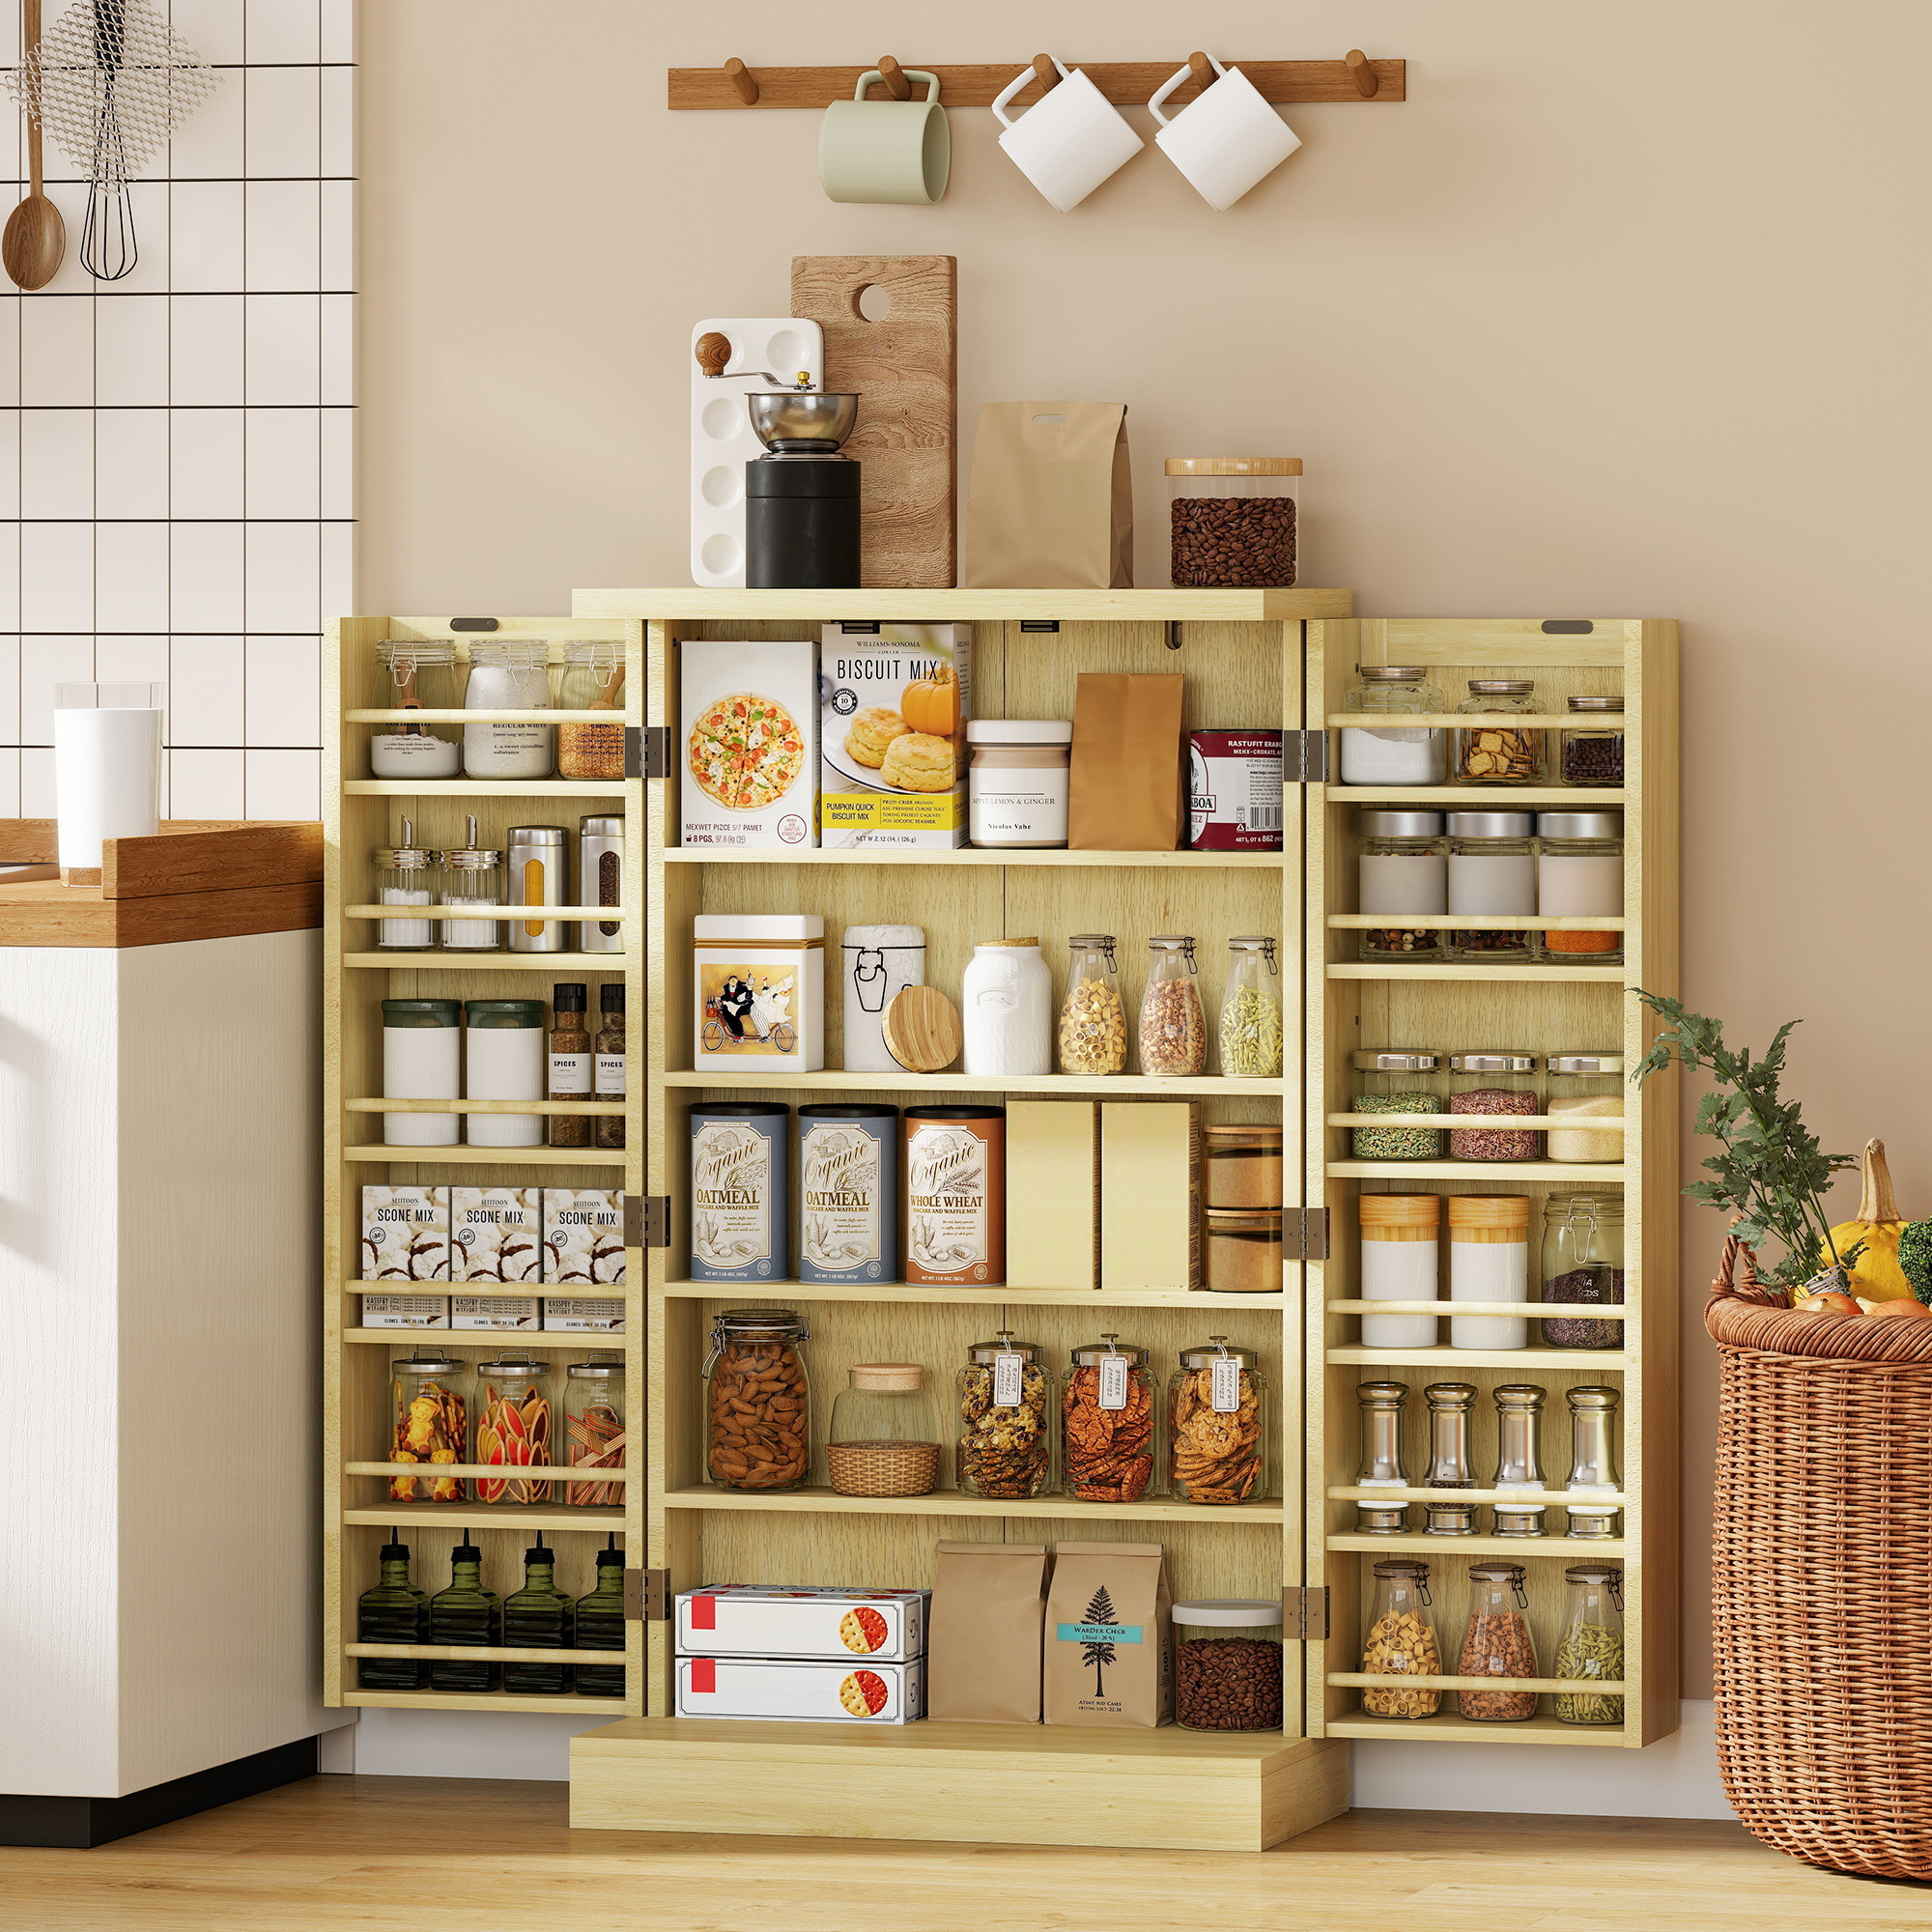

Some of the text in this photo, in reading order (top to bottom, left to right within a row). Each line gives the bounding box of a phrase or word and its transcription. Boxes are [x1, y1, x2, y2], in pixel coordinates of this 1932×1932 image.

[837, 659, 938, 680] BISCUIT MIX
[826, 803, 875, 811] PUMPKIN QUICK
[696, 1138, 759, 1189] Organic
[805, 1141, 869, 1190] Organic
[910, 1142, 977, 1192] Organic
[696, 1188, 760, 1205] OATMEAL
[806, 1190, 870, 1207] OATMEAL
[910, 1194, 983, 1208] WHOLE WHEAT
[377, 1208, 434, 1222] SCONE MIX
[467, 1209, 524, 1224] SCONE MIX
[558, 1211, 616, 1226] SCONE MIX
